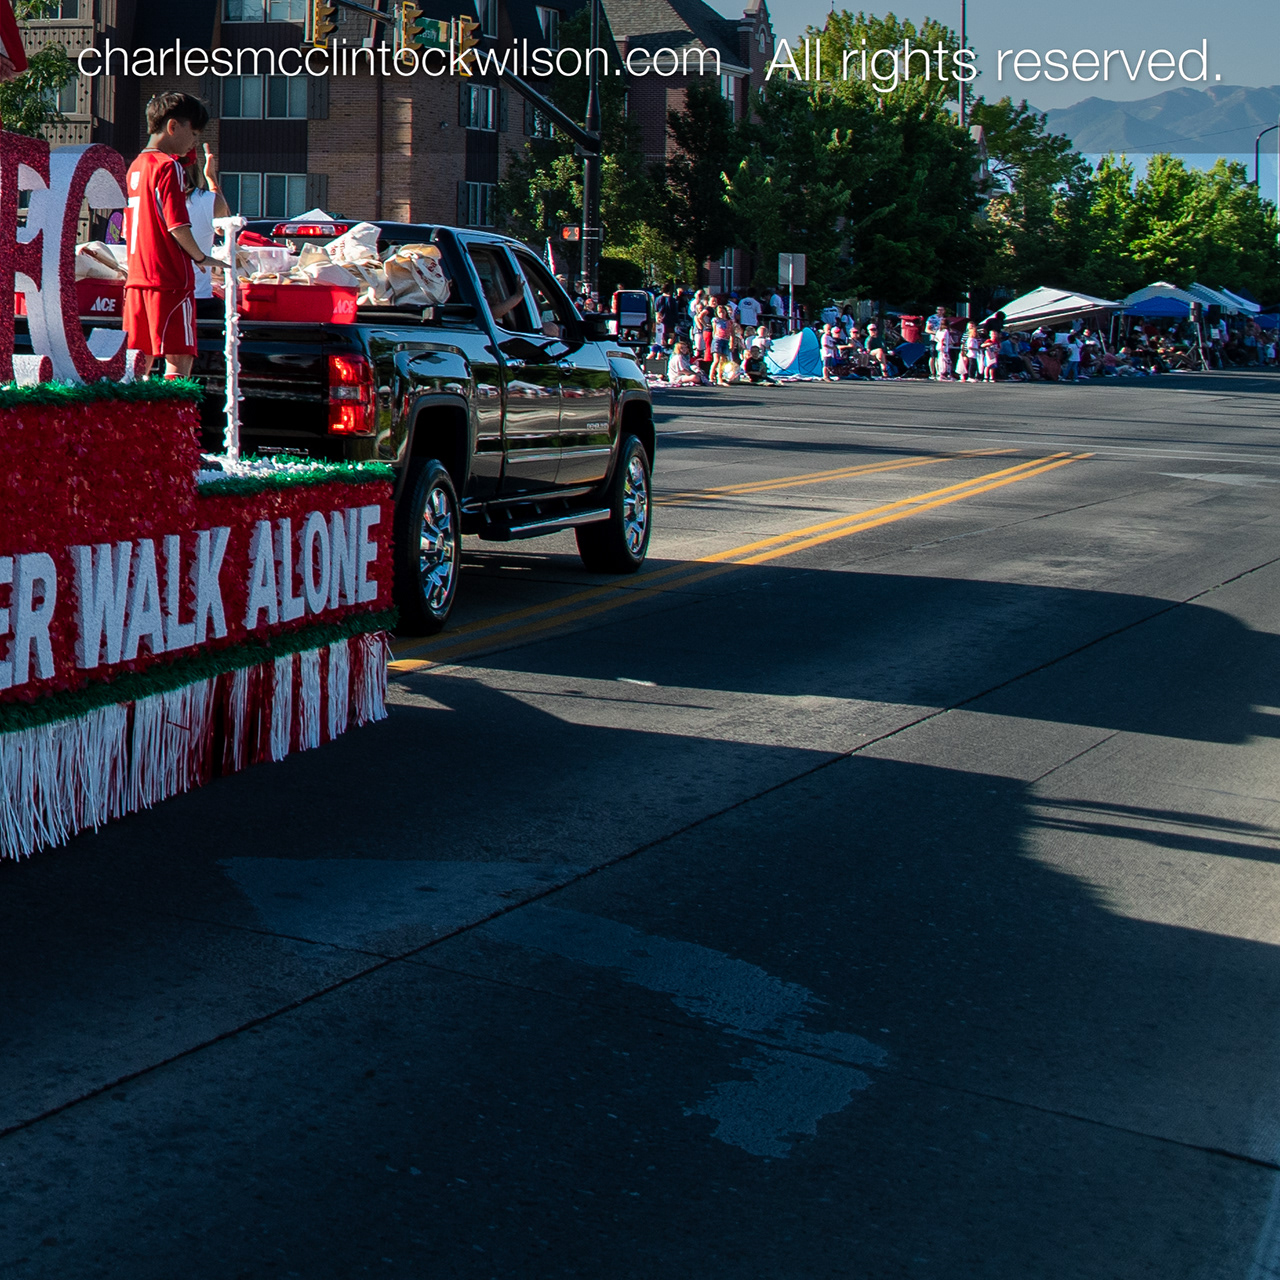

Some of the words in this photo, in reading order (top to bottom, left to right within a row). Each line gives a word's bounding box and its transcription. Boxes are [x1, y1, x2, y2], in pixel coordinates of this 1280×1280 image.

[90, 296, 116, 312] ACE
[333, 299, 355, 314] ACE
[71, 526, 231, 670] WALK
[243, 505, 381, 630] ALONE
